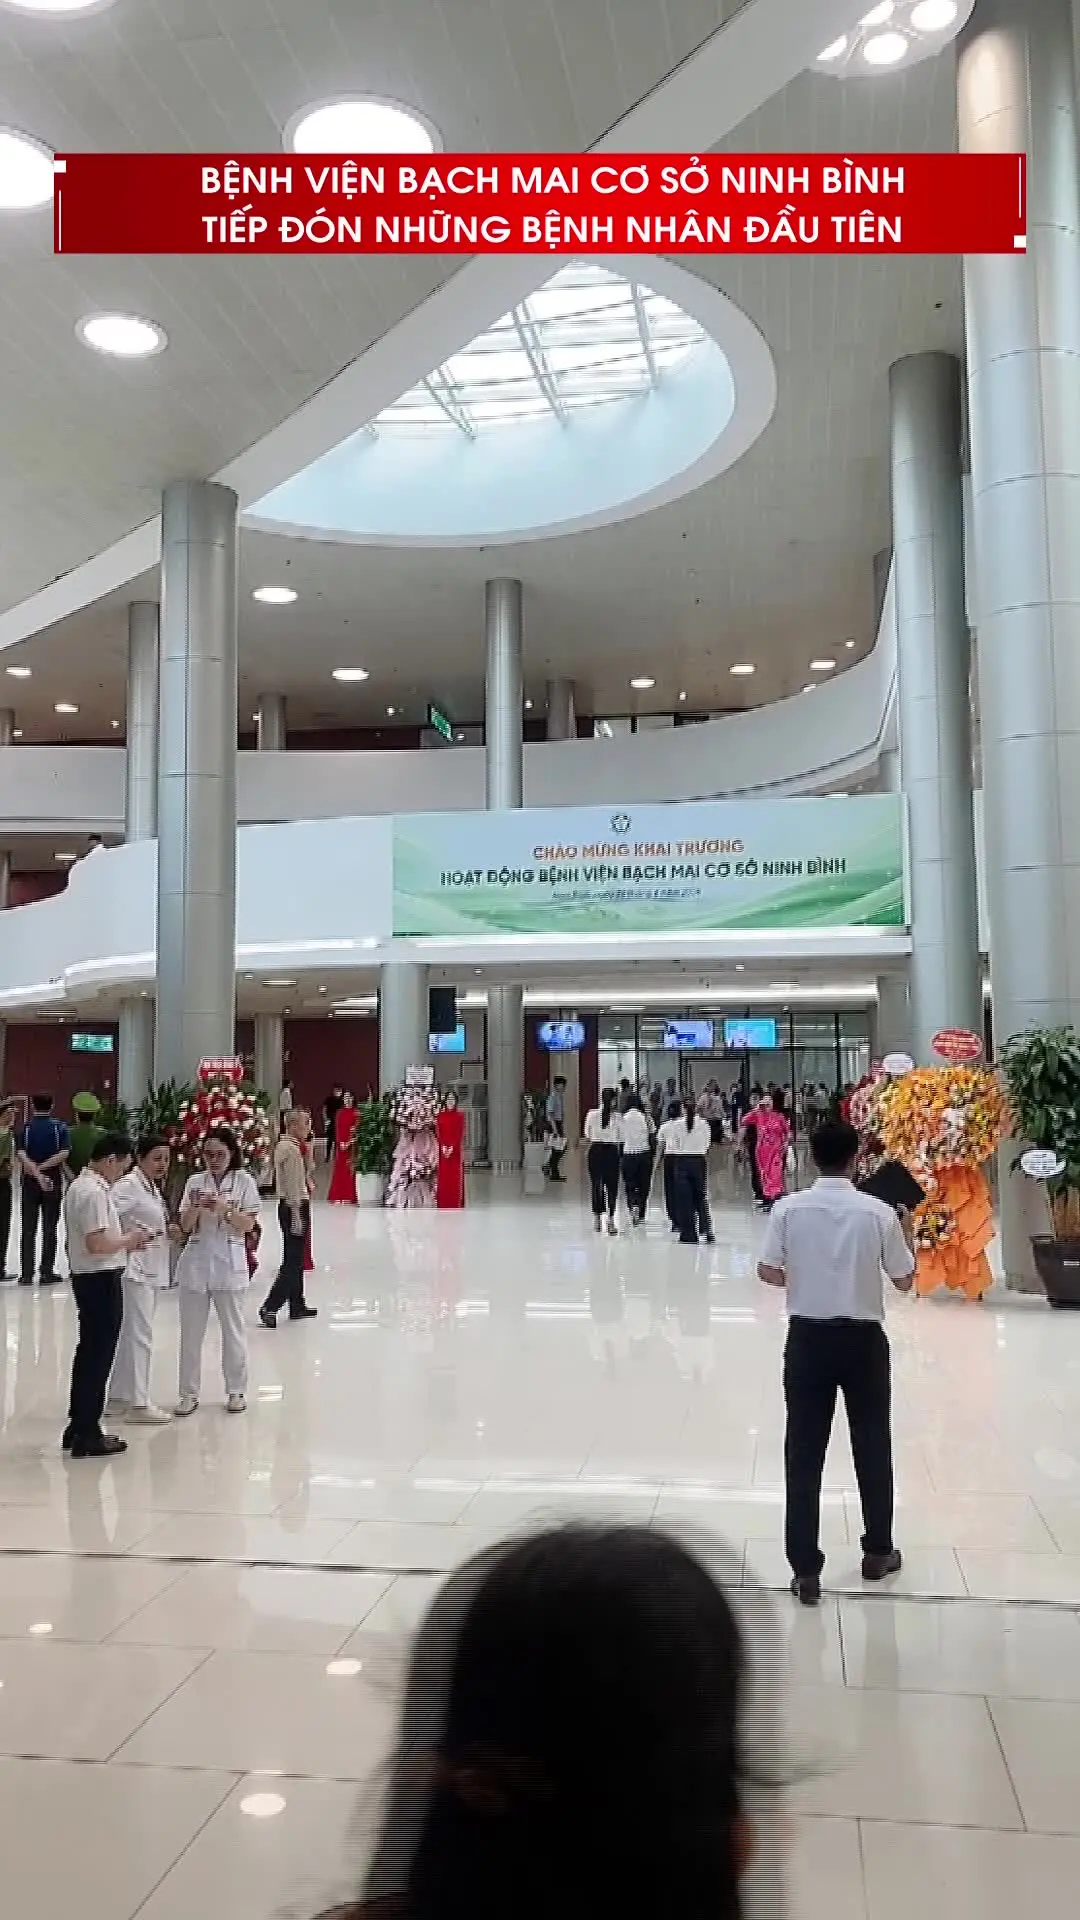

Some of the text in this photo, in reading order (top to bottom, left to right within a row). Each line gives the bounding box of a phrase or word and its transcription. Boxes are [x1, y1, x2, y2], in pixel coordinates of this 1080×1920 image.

[634, 841, 671, 857] KHAI
[440, 856, 847, 887] HOẠT ĐỘNG BỆNH VIỆN BẠCH MAI CƠ SỞ NINH BÌNH
